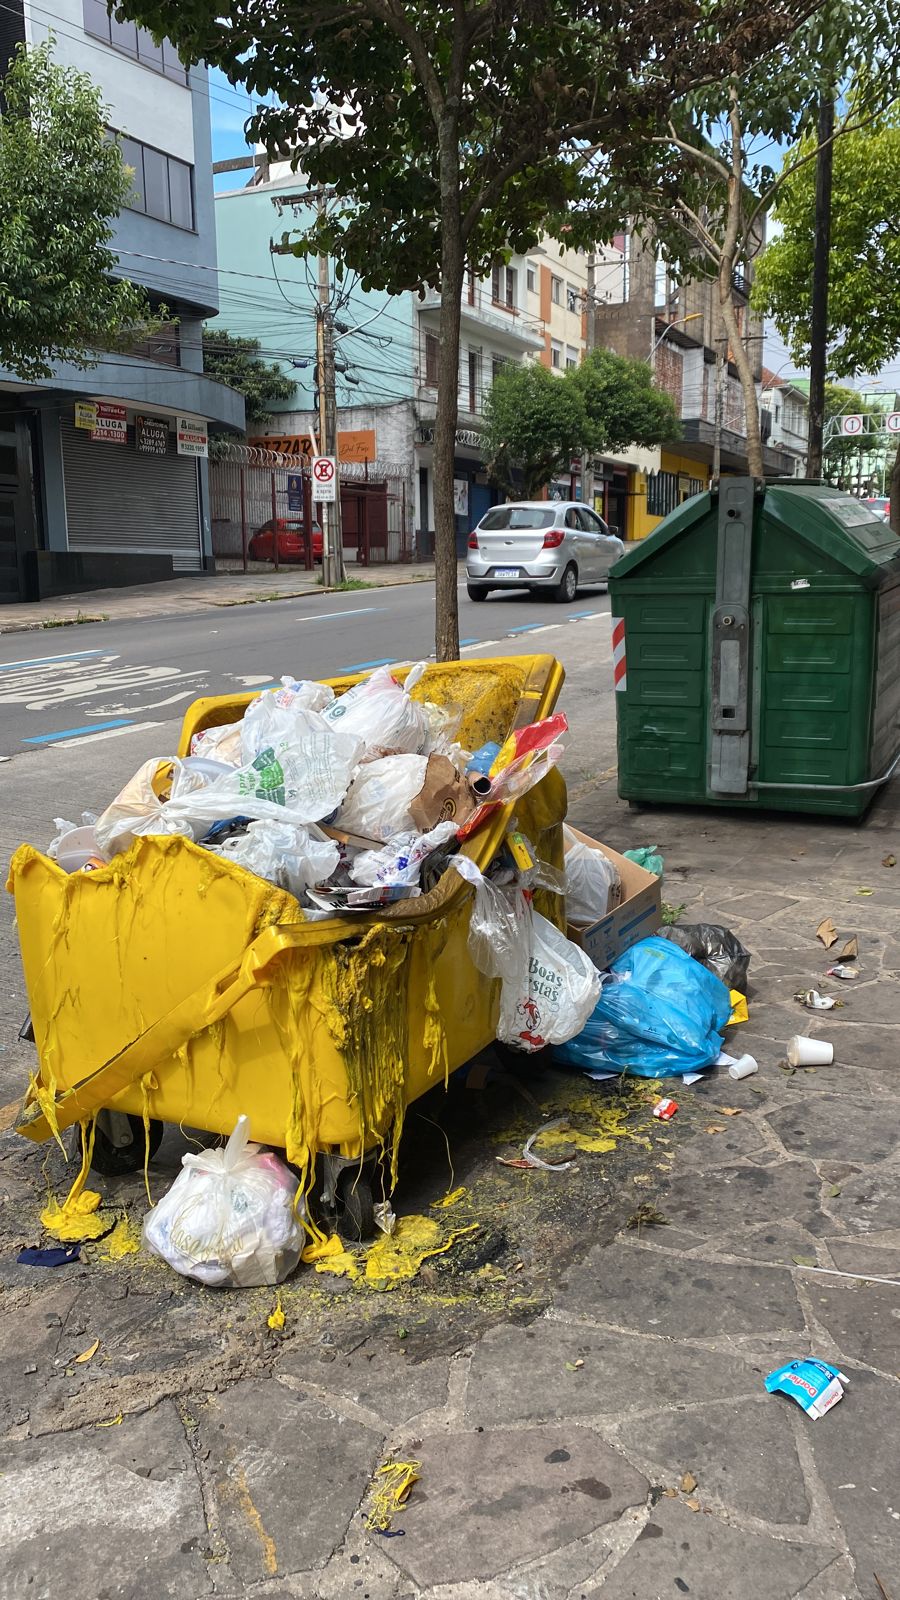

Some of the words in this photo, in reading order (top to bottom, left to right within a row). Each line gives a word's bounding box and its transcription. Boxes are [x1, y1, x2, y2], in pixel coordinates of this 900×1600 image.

[96, 419, 123, 430] ALUGA
[141, 428, 165, 439] ALUGA
[183, 434, 202, 442] ALUGA
[528, 957, 563, 987] Boas
